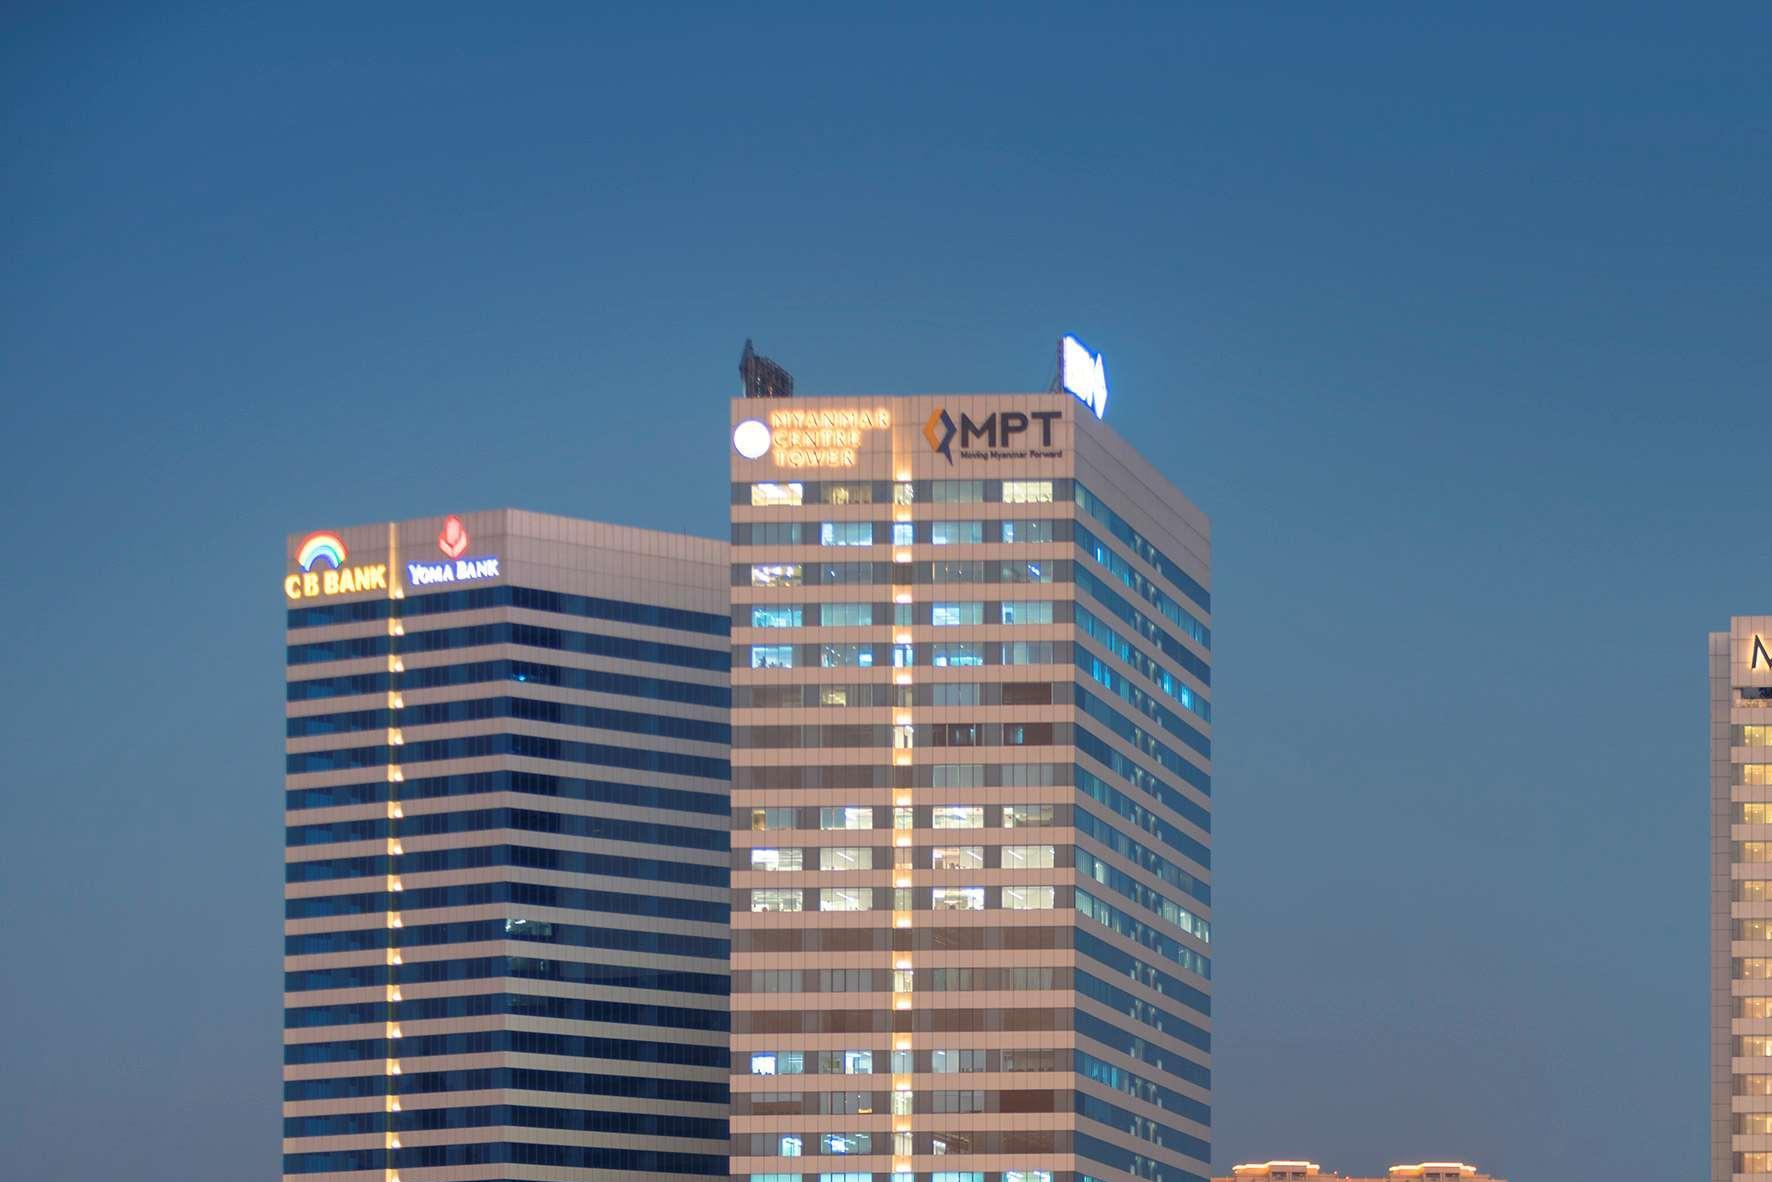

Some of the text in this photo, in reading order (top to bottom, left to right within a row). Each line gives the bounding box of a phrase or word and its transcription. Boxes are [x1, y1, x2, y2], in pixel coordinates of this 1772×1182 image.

[772, 410, 889, 429] MYANMAR
[773, 430, 860, 448] CENTRE
[960, 412, 1062, 448] MPT
[774, 448, 856, 467] TOWER
[961, 449, 1062, 460] Moving Myanmar Forward
[324, 564, 387, 594] BANK
[456, 559, 500, 580] BANK
